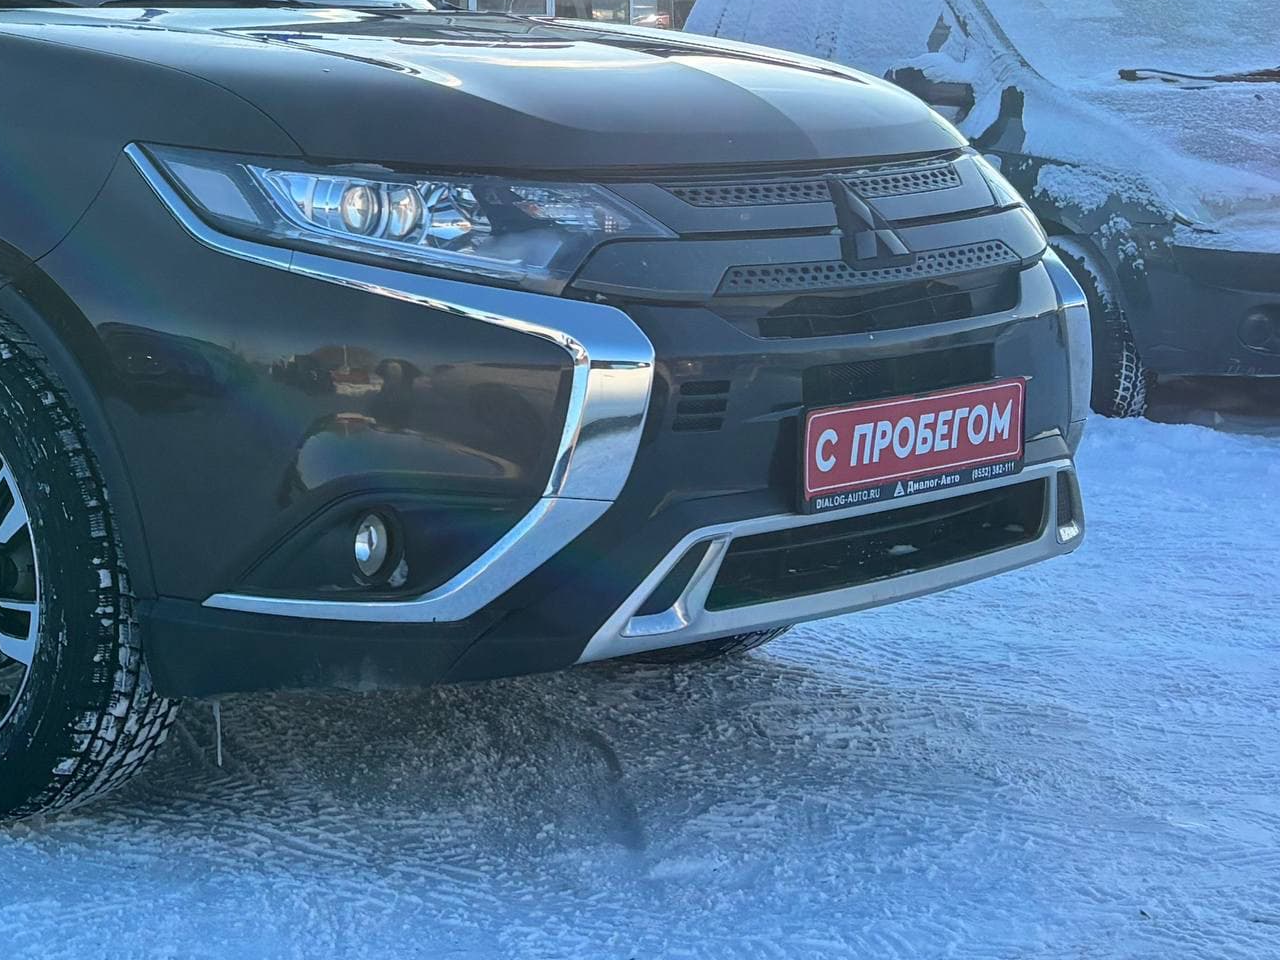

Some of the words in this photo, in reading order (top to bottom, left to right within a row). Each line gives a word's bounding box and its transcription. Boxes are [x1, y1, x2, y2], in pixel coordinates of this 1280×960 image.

[815, 428, 839, 472] С
[850, 399, 1013, 467] ПРОБЕГОМ
[816, 488, 881, 510] DIALOG-AUTO.RU
[906, 473, 960, 494] Диалог-Авто
